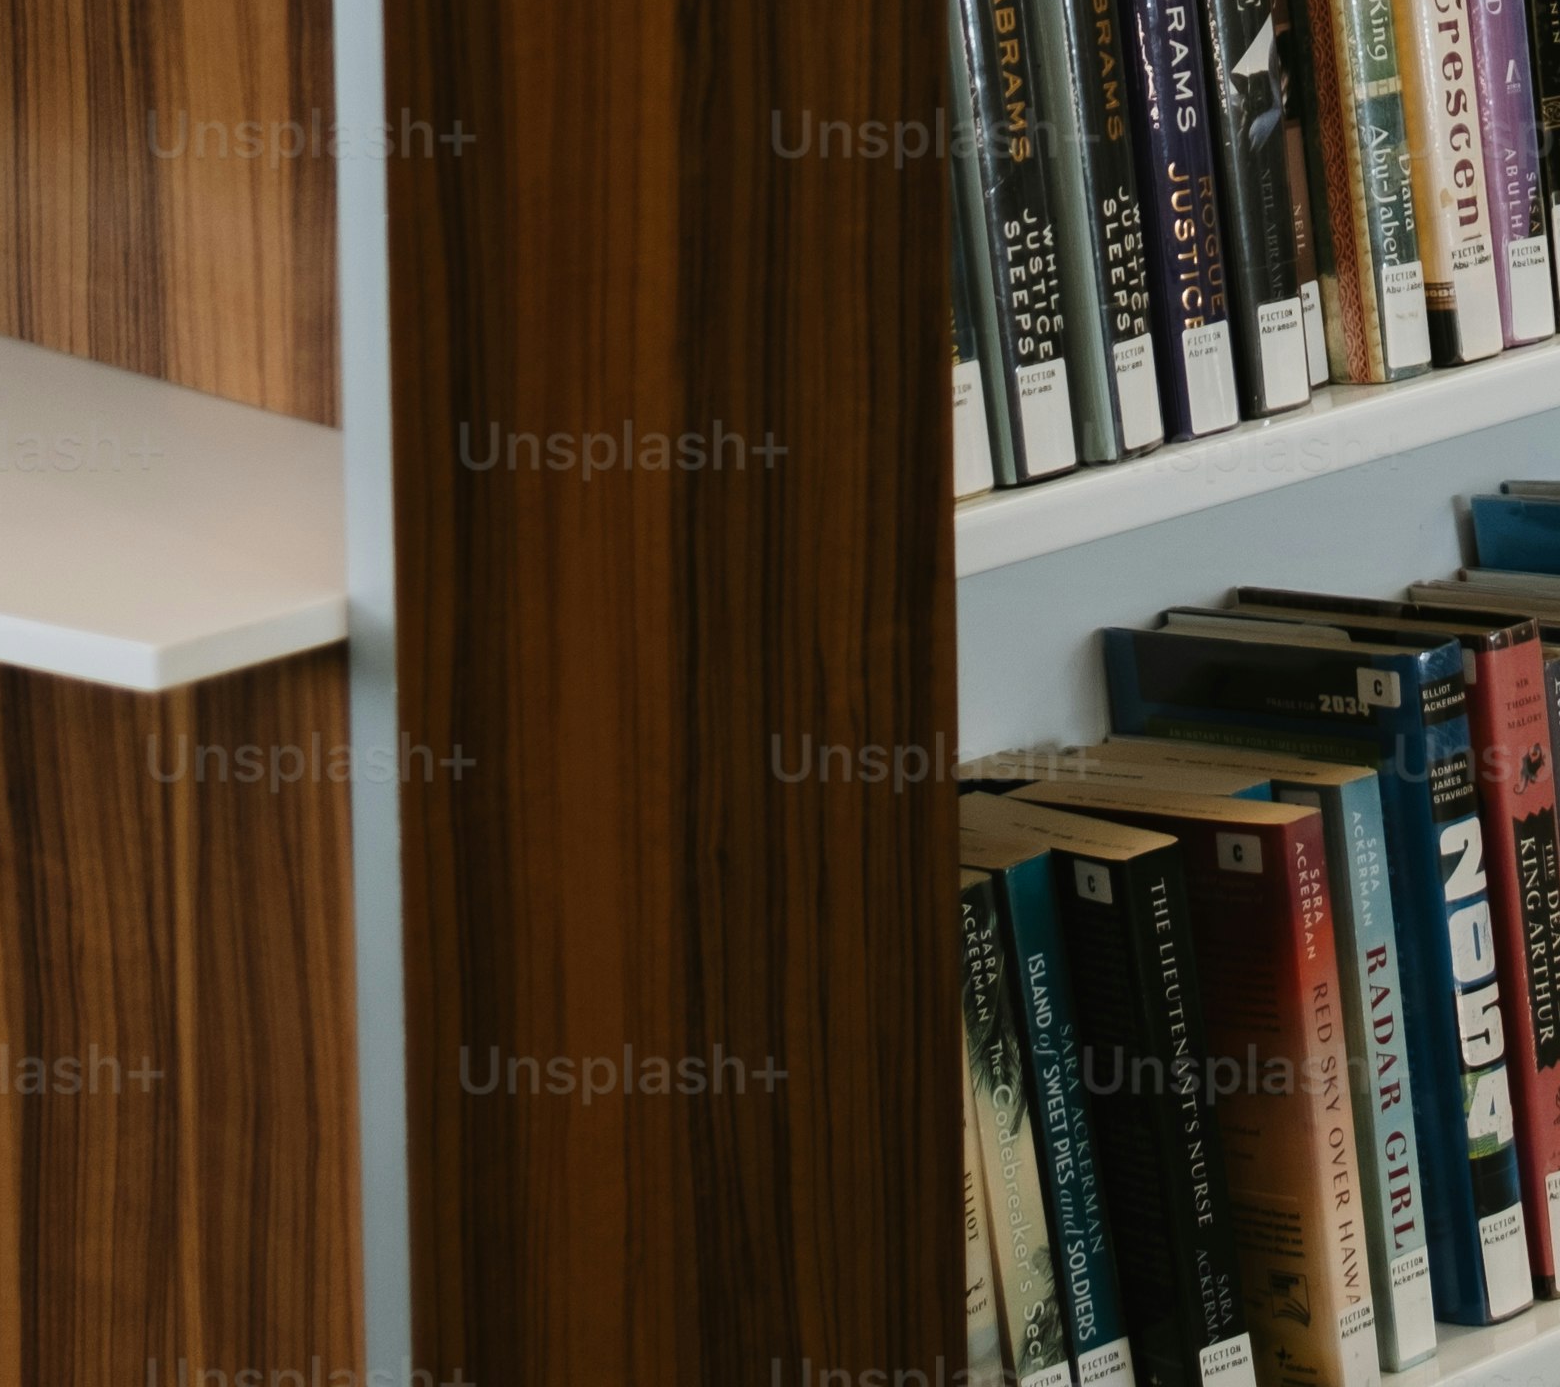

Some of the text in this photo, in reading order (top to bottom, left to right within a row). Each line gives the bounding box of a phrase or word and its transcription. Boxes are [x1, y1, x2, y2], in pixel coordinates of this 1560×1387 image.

[1368, 123, 1397, 266] Abu-Jaber
[1003, 220, 1034, 355] SLEEPS
[1022, 208, 1054, 359] JUSTICE
[1422, 683, 1451, 699] ELLIOT
[1423, 691, 1466, 714] ACKERMAN
[1519, 838, 1555, 1044] KING ARTHUR
[1149, 877, 1214, 1228] THE LIEUTENANT'S NURSE
[1365, 941, 1417, 1250] RADAR GIRL
[1027, 953, 1096, 1342] ISLAND of SWEET PIES and SOLDIERS
